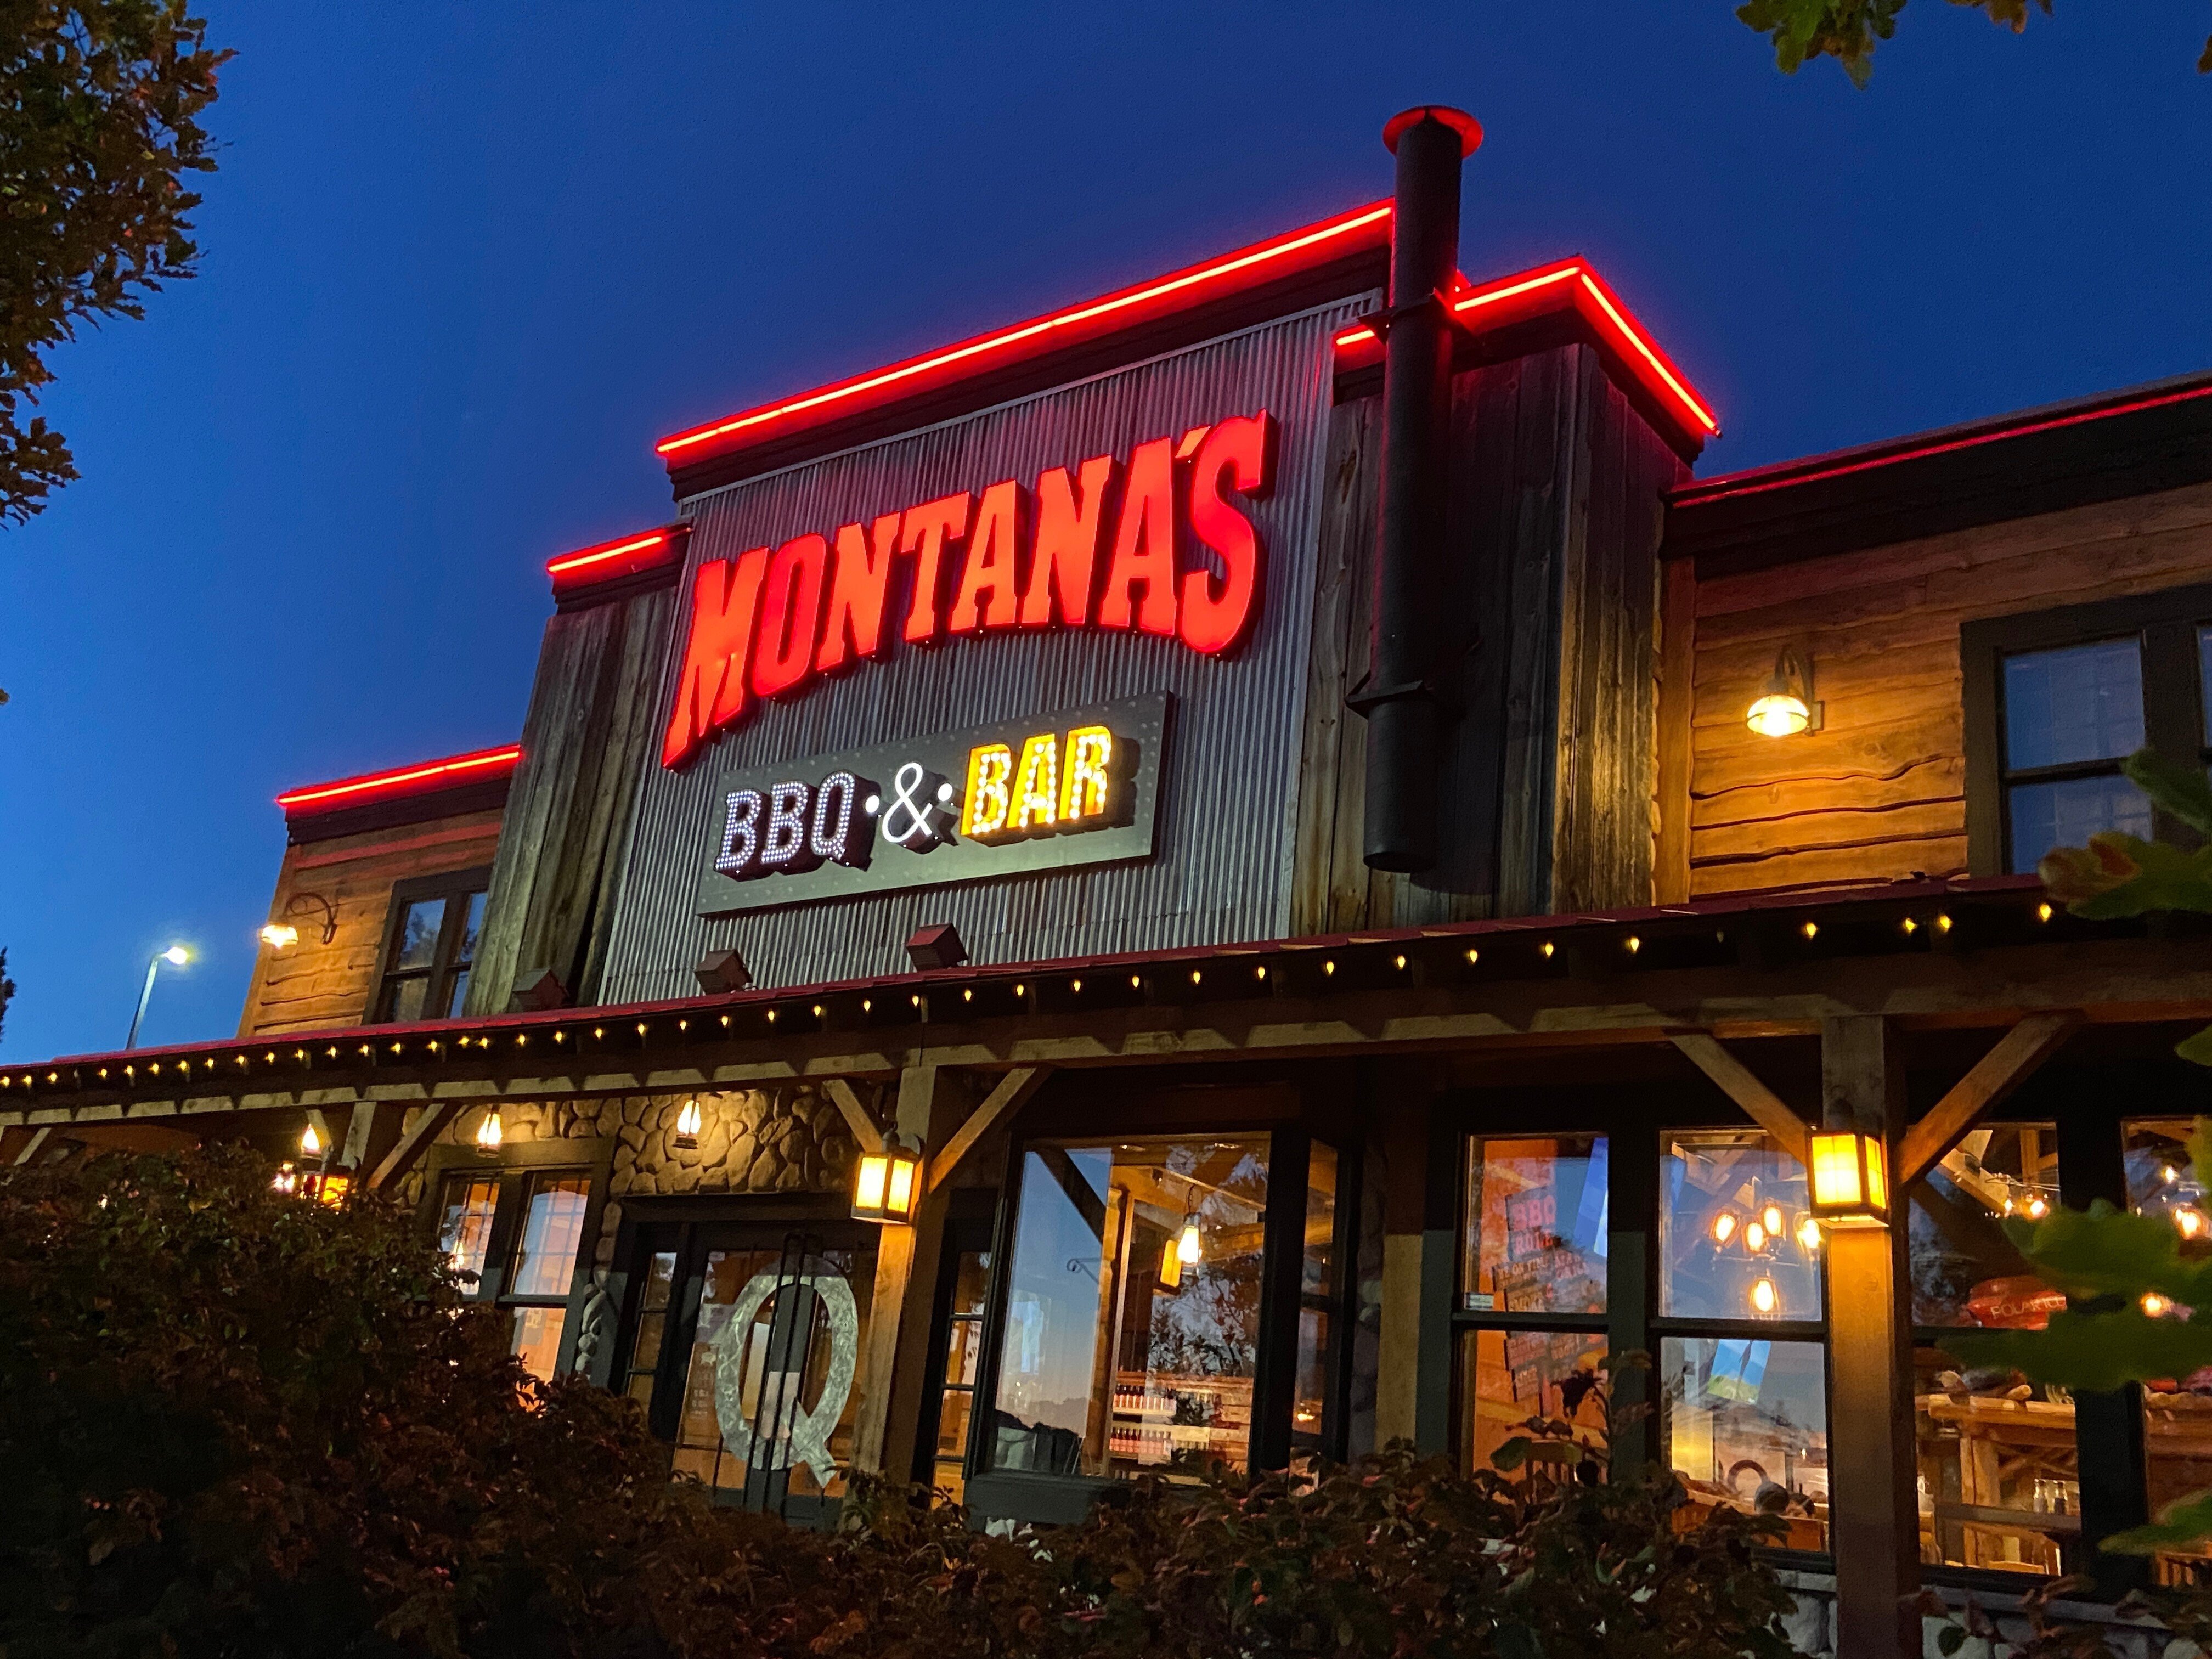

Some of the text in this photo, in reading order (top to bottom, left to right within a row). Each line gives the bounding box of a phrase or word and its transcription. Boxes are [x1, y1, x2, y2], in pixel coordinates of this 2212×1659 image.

[663, 408, 1267, 769] MONTANA'S
[715, 771, 857, 871] BBQ
[960, 725, 1112, 836] BAR
[715, 1253, 859, 1488] Q
